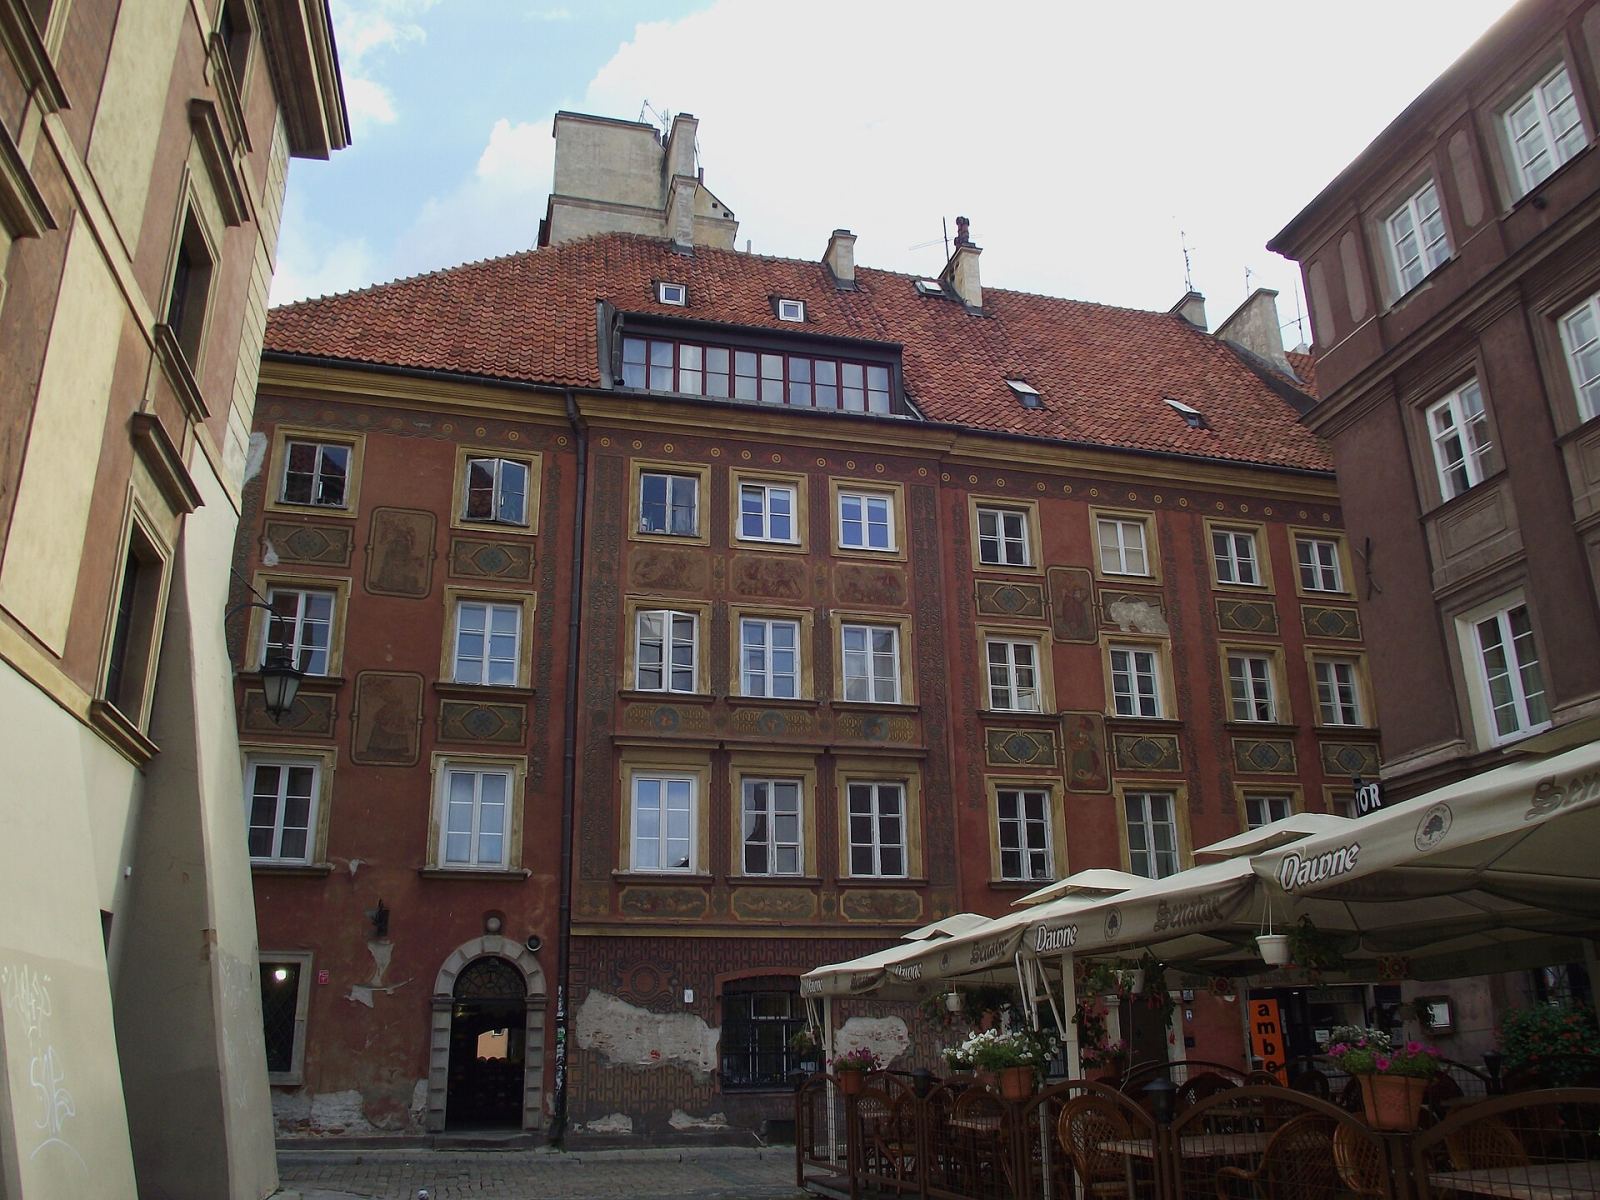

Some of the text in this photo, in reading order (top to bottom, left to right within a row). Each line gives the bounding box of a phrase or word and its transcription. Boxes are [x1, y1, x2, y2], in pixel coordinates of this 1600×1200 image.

[1279, 841, 1361, 892] Dawne
[1035, 923, 1079, 953] Dawne
[1257, 1003, 1278, 1073] ambe
